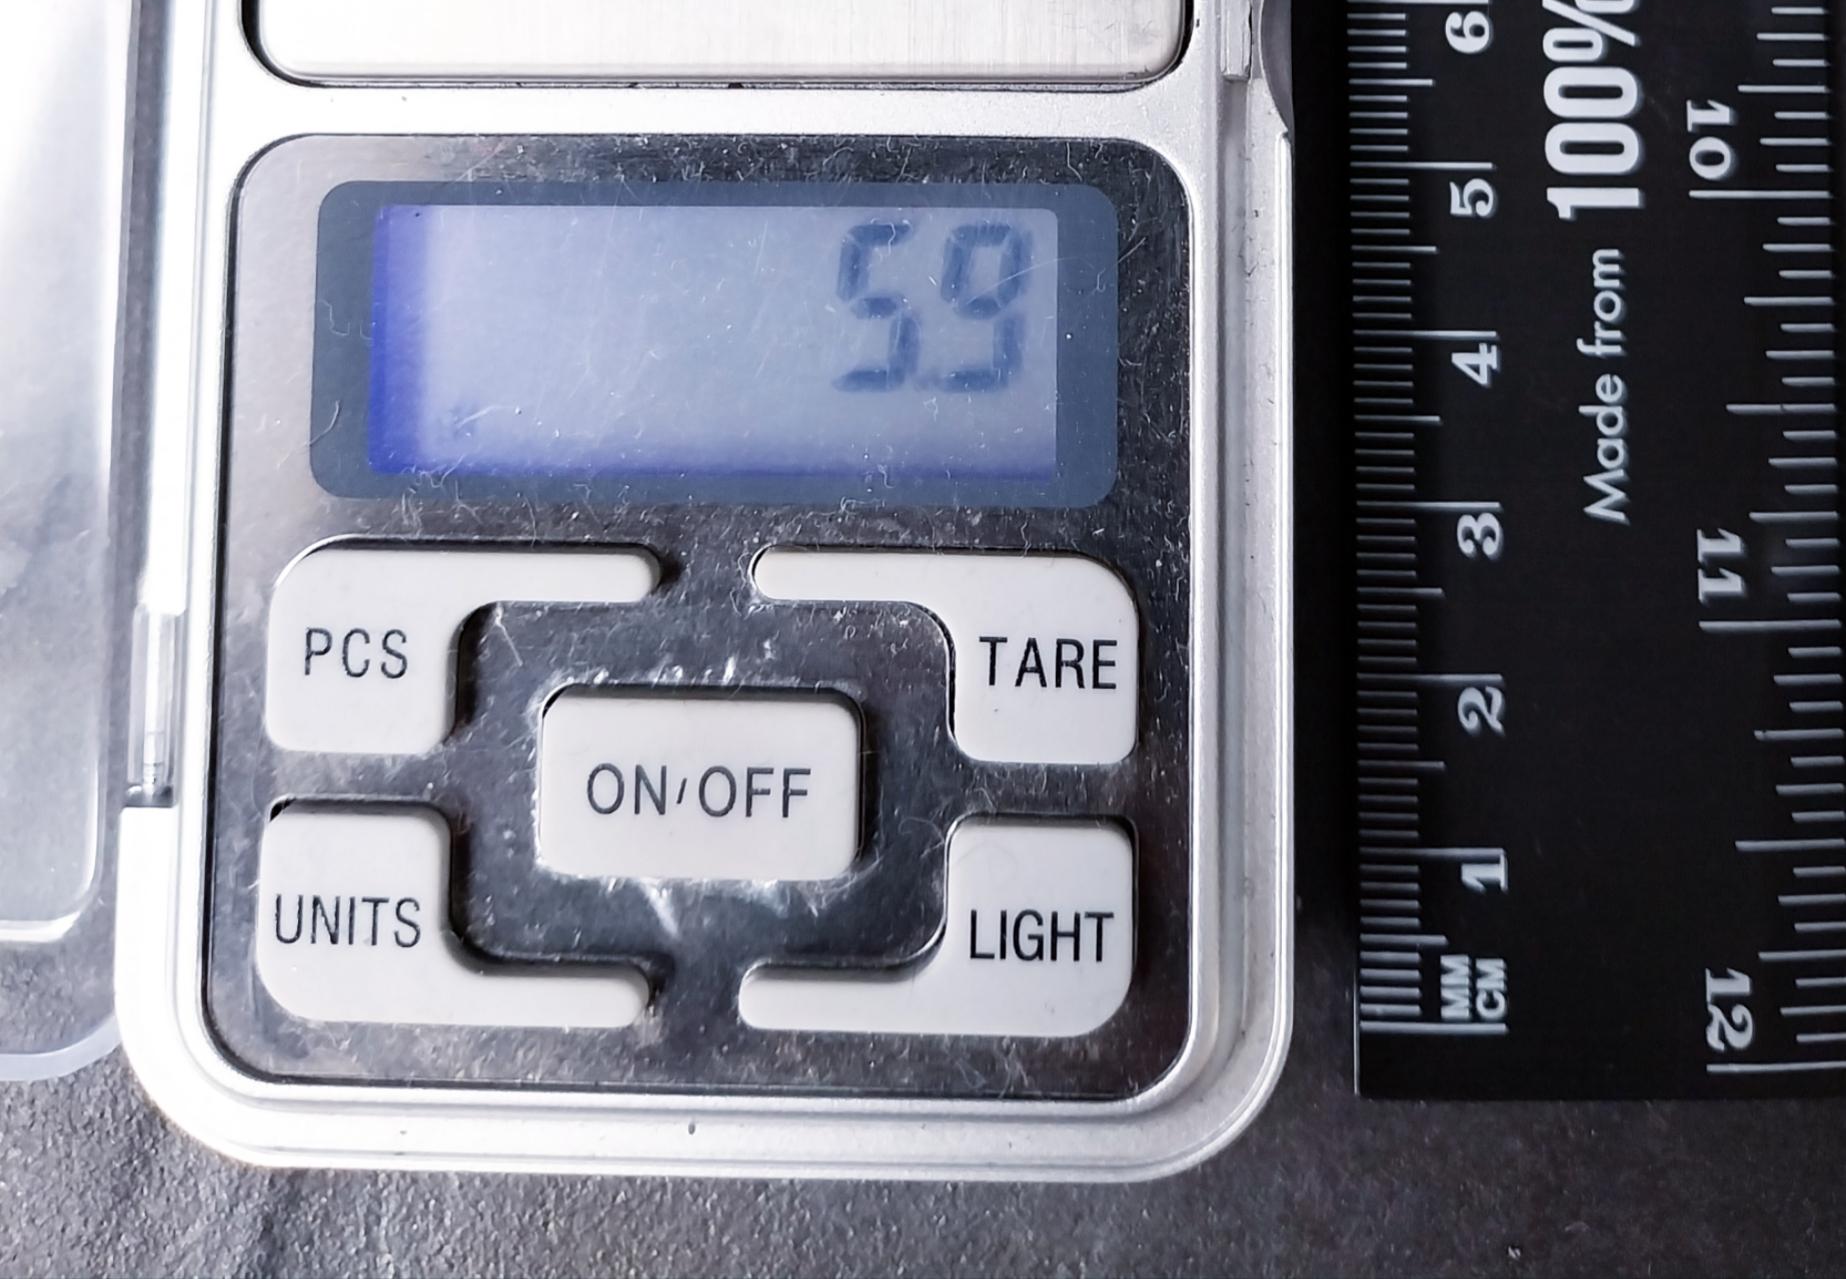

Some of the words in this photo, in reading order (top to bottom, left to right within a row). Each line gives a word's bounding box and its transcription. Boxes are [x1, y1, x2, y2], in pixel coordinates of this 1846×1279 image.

[1445, 11, 1492, 53] 6
[1686, 99, 1735, 179] 10
[1450, 178, 1495, 218] 5
[1577, 248, 1626, 356] from
[1451, 342, 1497, 387] 4
[1578, 373, 1630, 523] Made
[1456, 513, 1502, 557] 3
[1697, 528, 1746, 603] 11
[303, 625, 409, 680] PCS
[979, 636, 1118, 690] TARE
[1457, 686, 1504, 735] 2
[1461, 855, 1508, 892] 1
[274, 895, 422, 948] UNITS
[967, 911, 1115, 964] LIGHT
[1440, 954, 1470, 1020] MM
[1475, 958, 1507, 1020] CM
[1704, 968, 1755, 1051] 12
